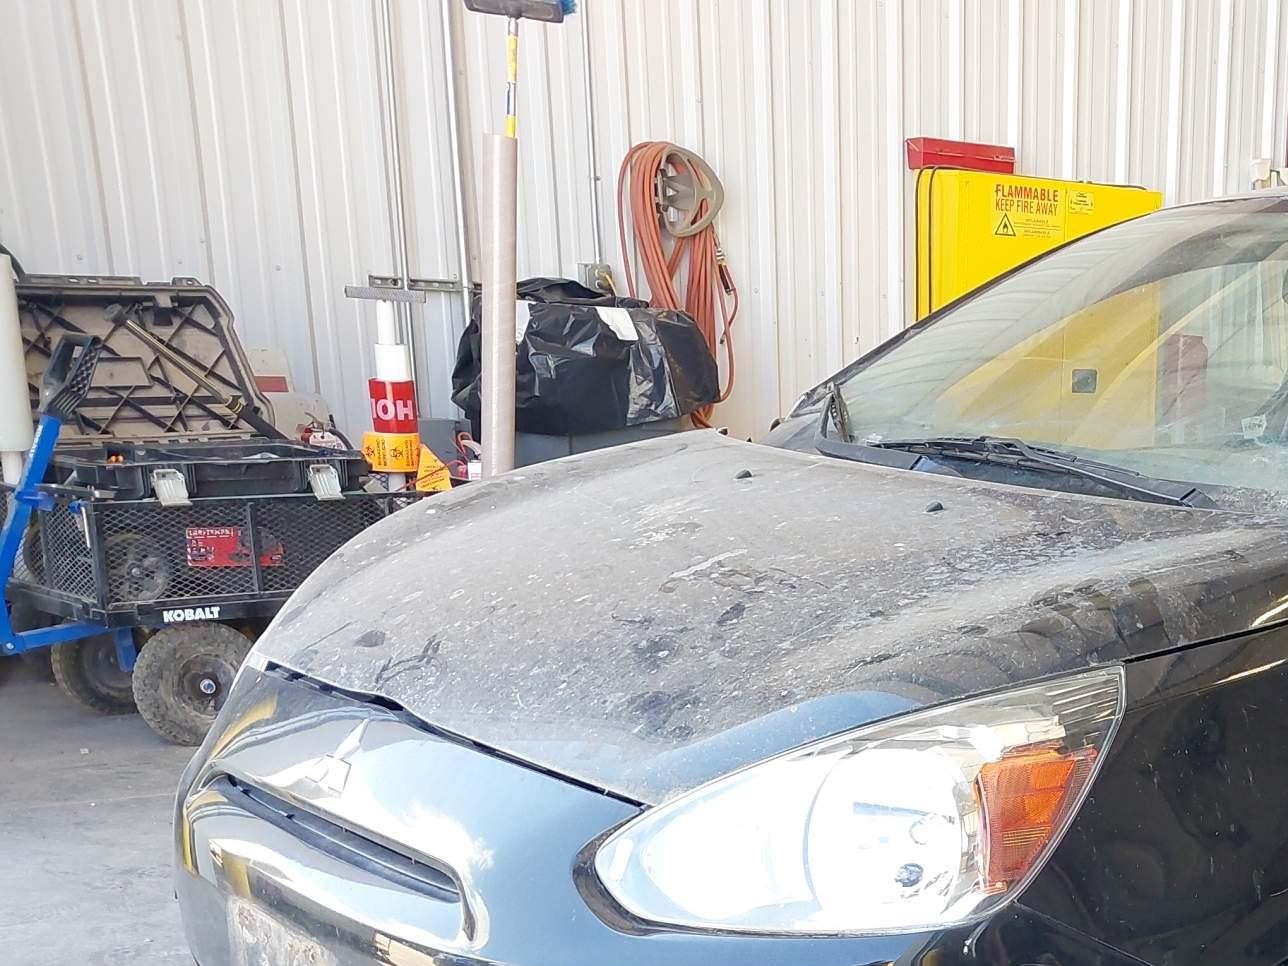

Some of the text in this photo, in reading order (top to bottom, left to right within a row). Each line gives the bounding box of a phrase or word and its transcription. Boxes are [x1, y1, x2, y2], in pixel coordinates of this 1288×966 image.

[995, 184, 1059, 203] FLAMMABLE
[995, 198, 1014, 212] KEEP
[1016, 200, 1034, 214] FIRE
[1036, 201, 1058, 216] AWAY
[162, 606, 221, 623] KOBALT
